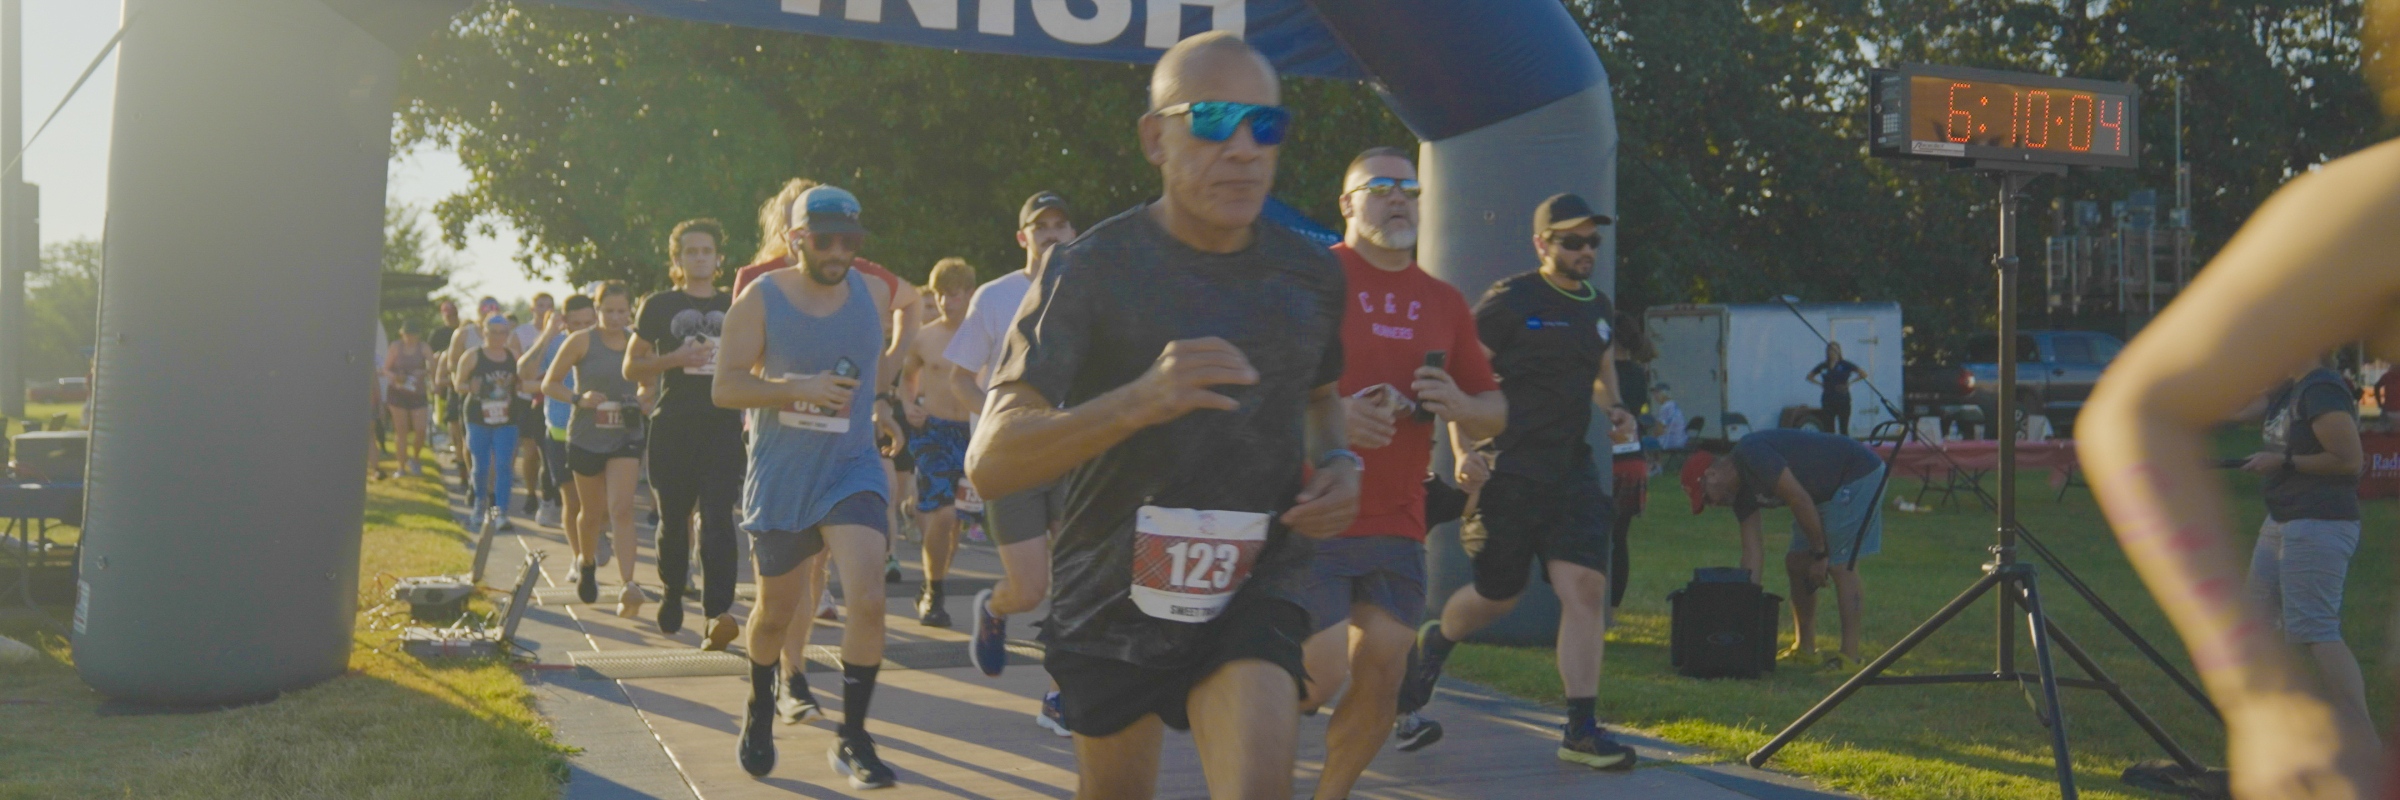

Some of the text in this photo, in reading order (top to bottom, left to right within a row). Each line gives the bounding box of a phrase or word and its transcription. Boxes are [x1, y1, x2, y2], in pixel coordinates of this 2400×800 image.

[1358, 291, 1374, 314] C
[1407, 300, 1421, 320] C
[1165, 541, 1240, 589] 123
